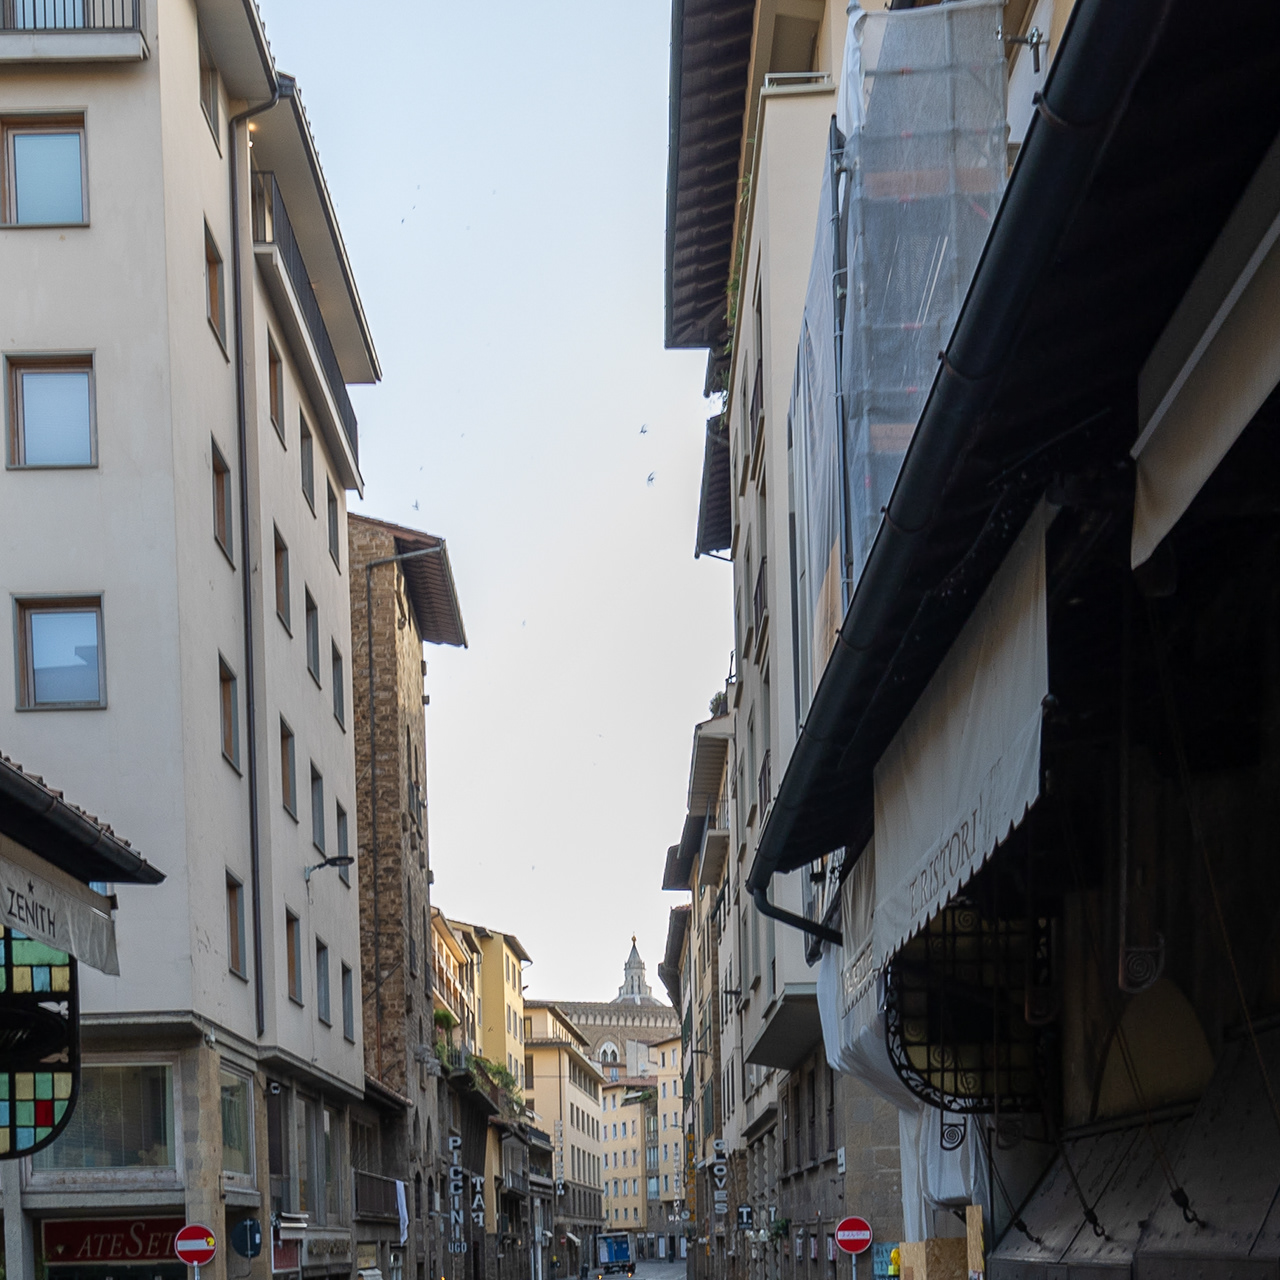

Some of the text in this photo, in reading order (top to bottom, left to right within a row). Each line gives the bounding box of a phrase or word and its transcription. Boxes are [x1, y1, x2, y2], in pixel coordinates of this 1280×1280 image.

[6, 889, 57, 937] ZENITH
[448, 1136, 464, 1239] PICCINI
[712, 1138, 729, 1214] GLOVES
[76, 1220, 177, 1259] ATESET
[448, 1241, 468, 1254] UGO
